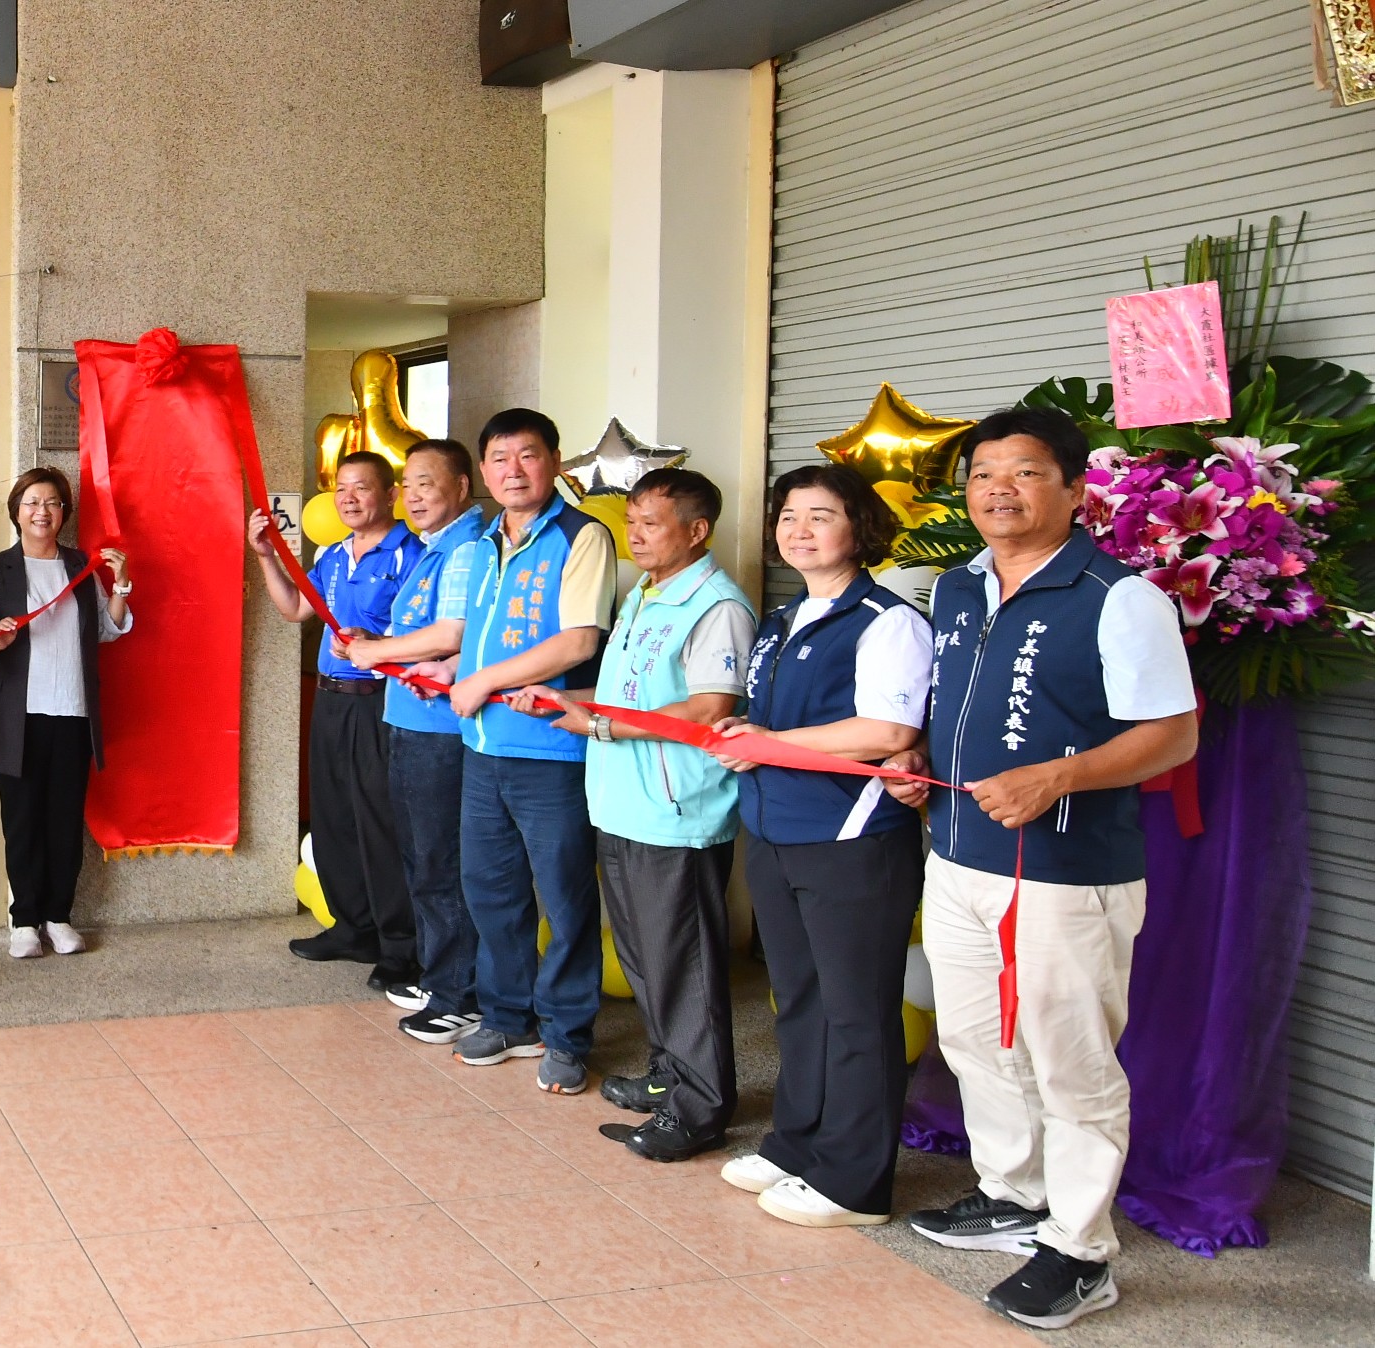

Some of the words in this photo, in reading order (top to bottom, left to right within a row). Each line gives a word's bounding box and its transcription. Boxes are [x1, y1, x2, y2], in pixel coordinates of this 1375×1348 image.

[1001, 620, 1048, 751] 和美鎮民代表會
